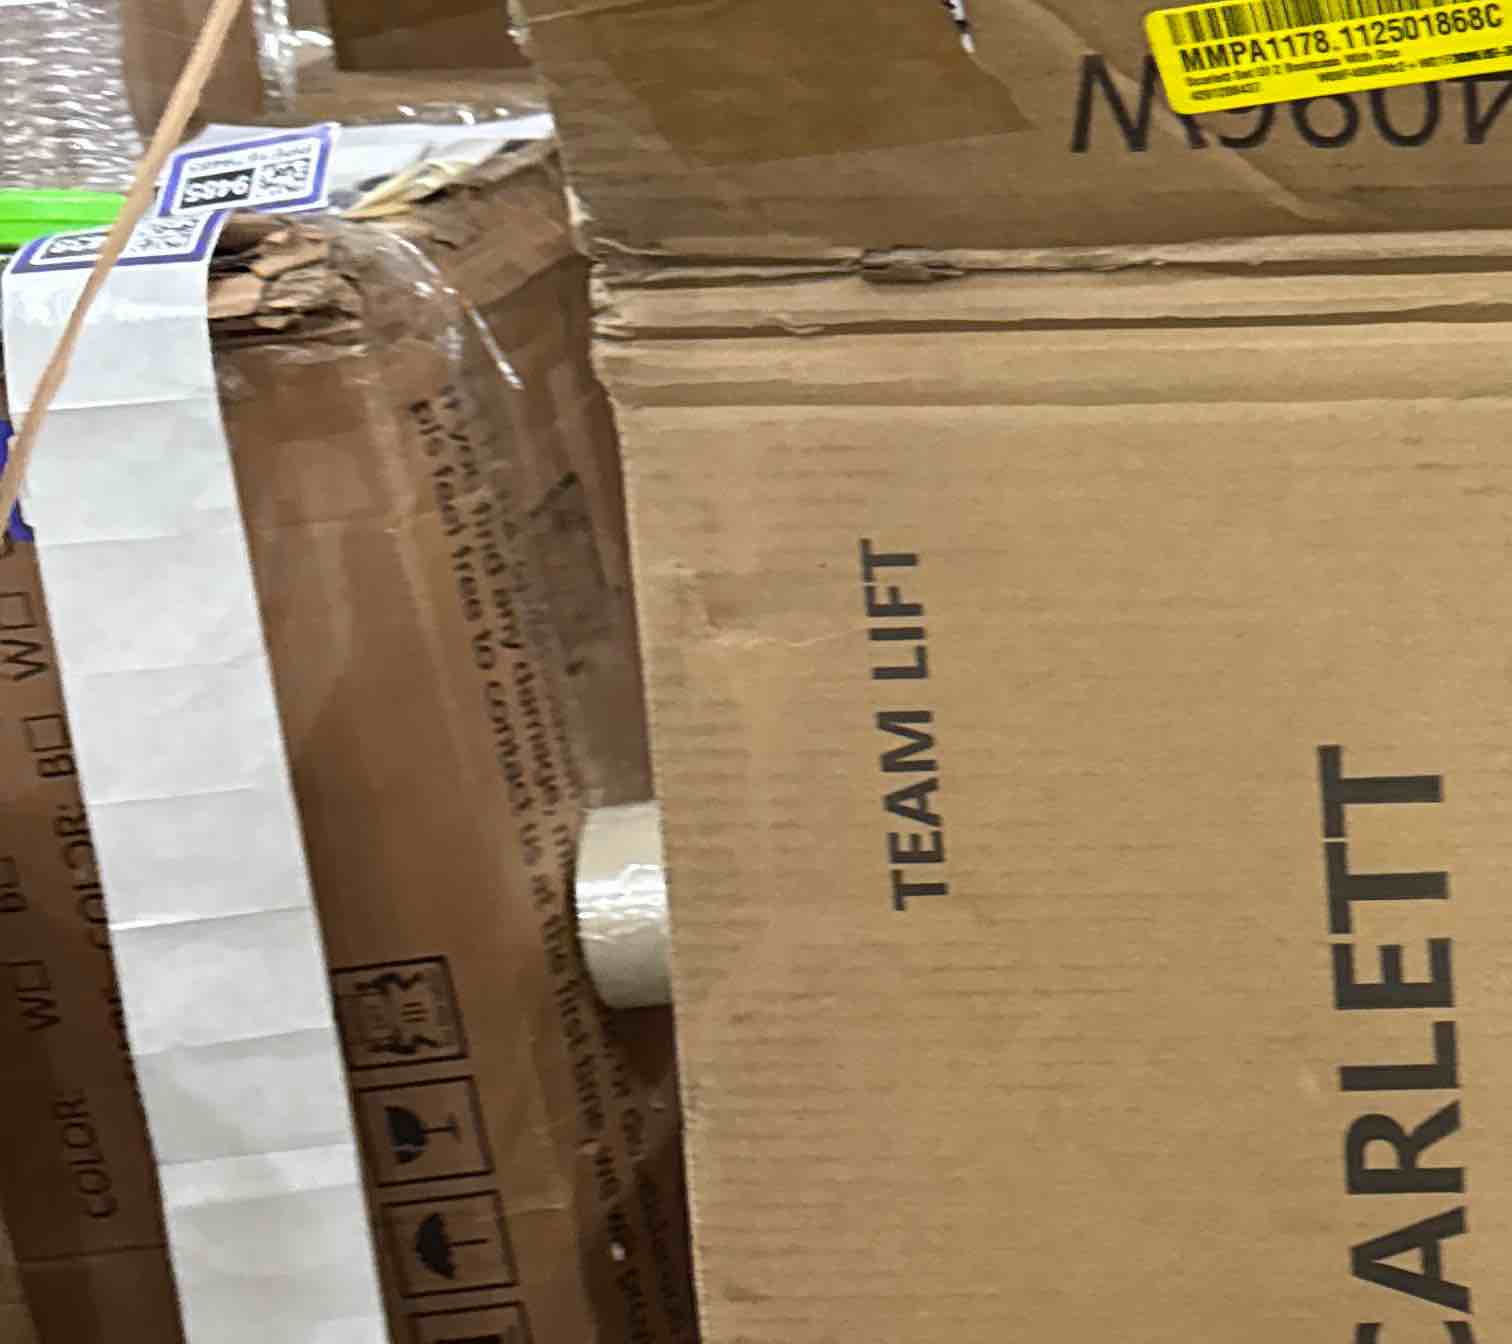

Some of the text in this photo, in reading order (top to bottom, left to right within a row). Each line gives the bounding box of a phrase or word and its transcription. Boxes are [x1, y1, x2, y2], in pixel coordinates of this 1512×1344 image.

[1179, 3, 1504, 74] MMPA1178.112501868C
[858, 536, 950, 912] TEAM LIFT
